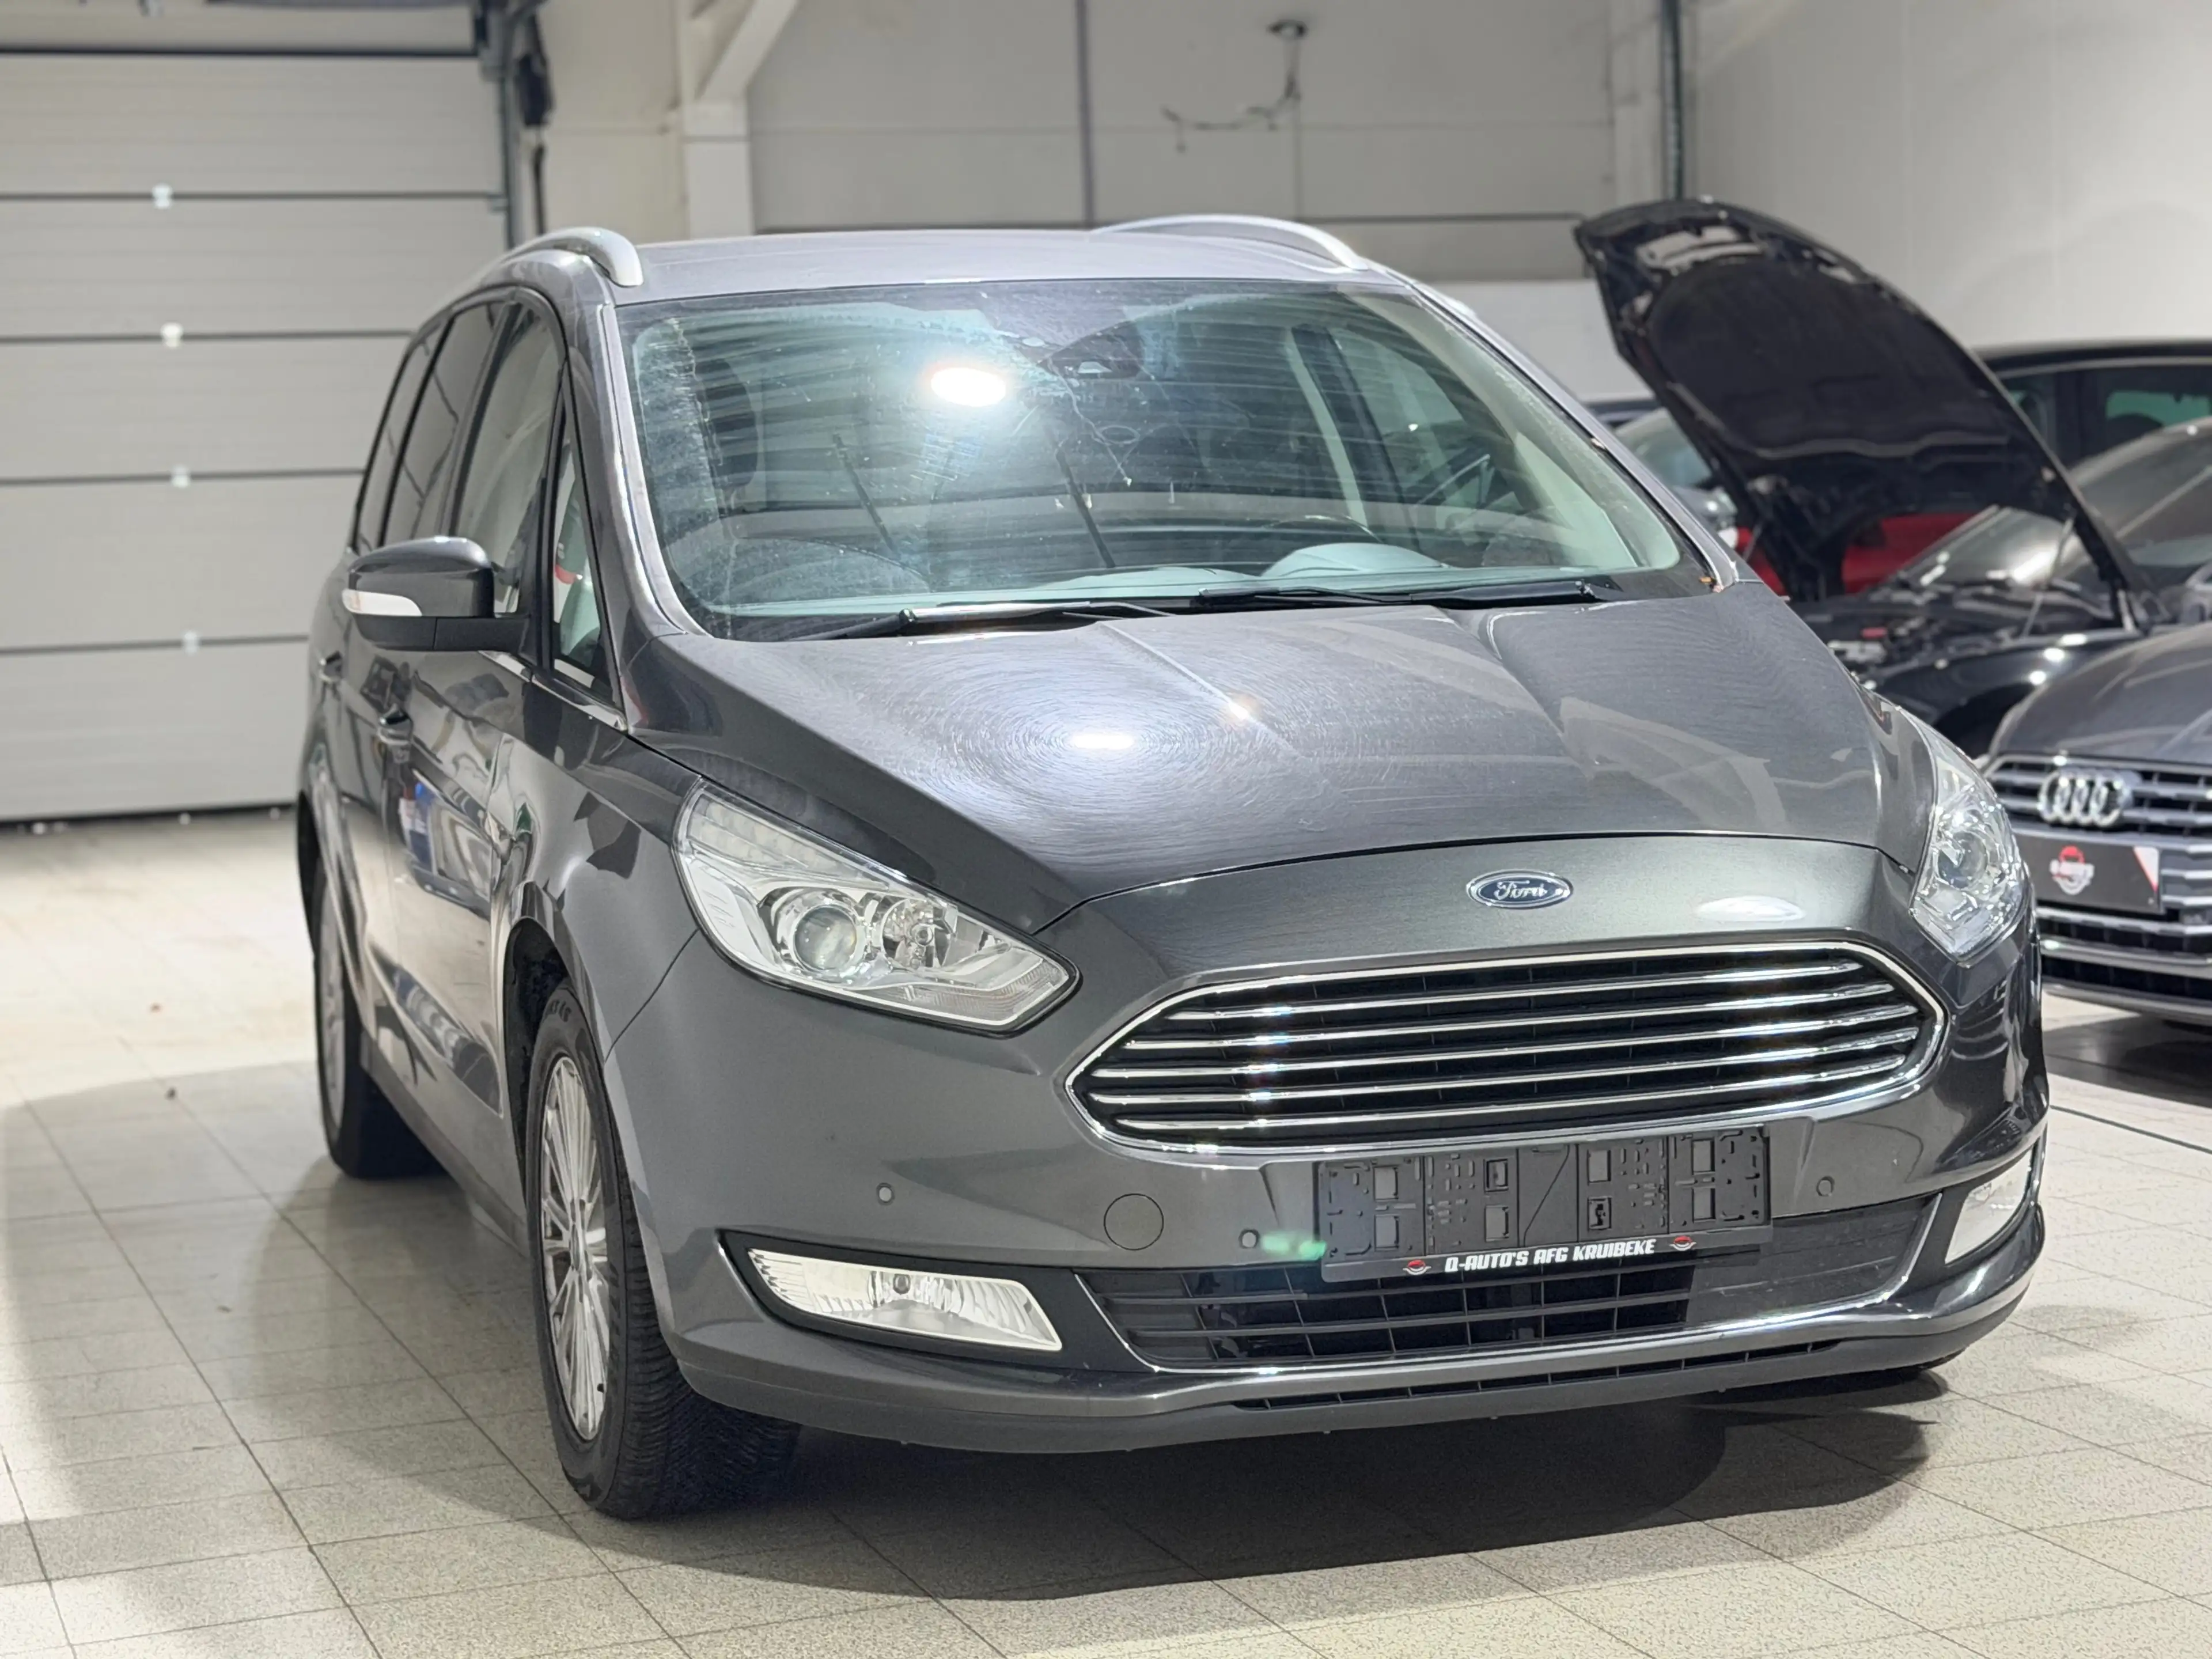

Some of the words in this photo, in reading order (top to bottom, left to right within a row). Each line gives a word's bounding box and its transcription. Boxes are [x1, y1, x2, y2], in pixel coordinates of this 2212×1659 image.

[1494, 880, 1548, 900] Ford
[1533, 1247, 1569, 1264] AFG
[1573, 1238, 1657, 1261] KRUIBEKE
